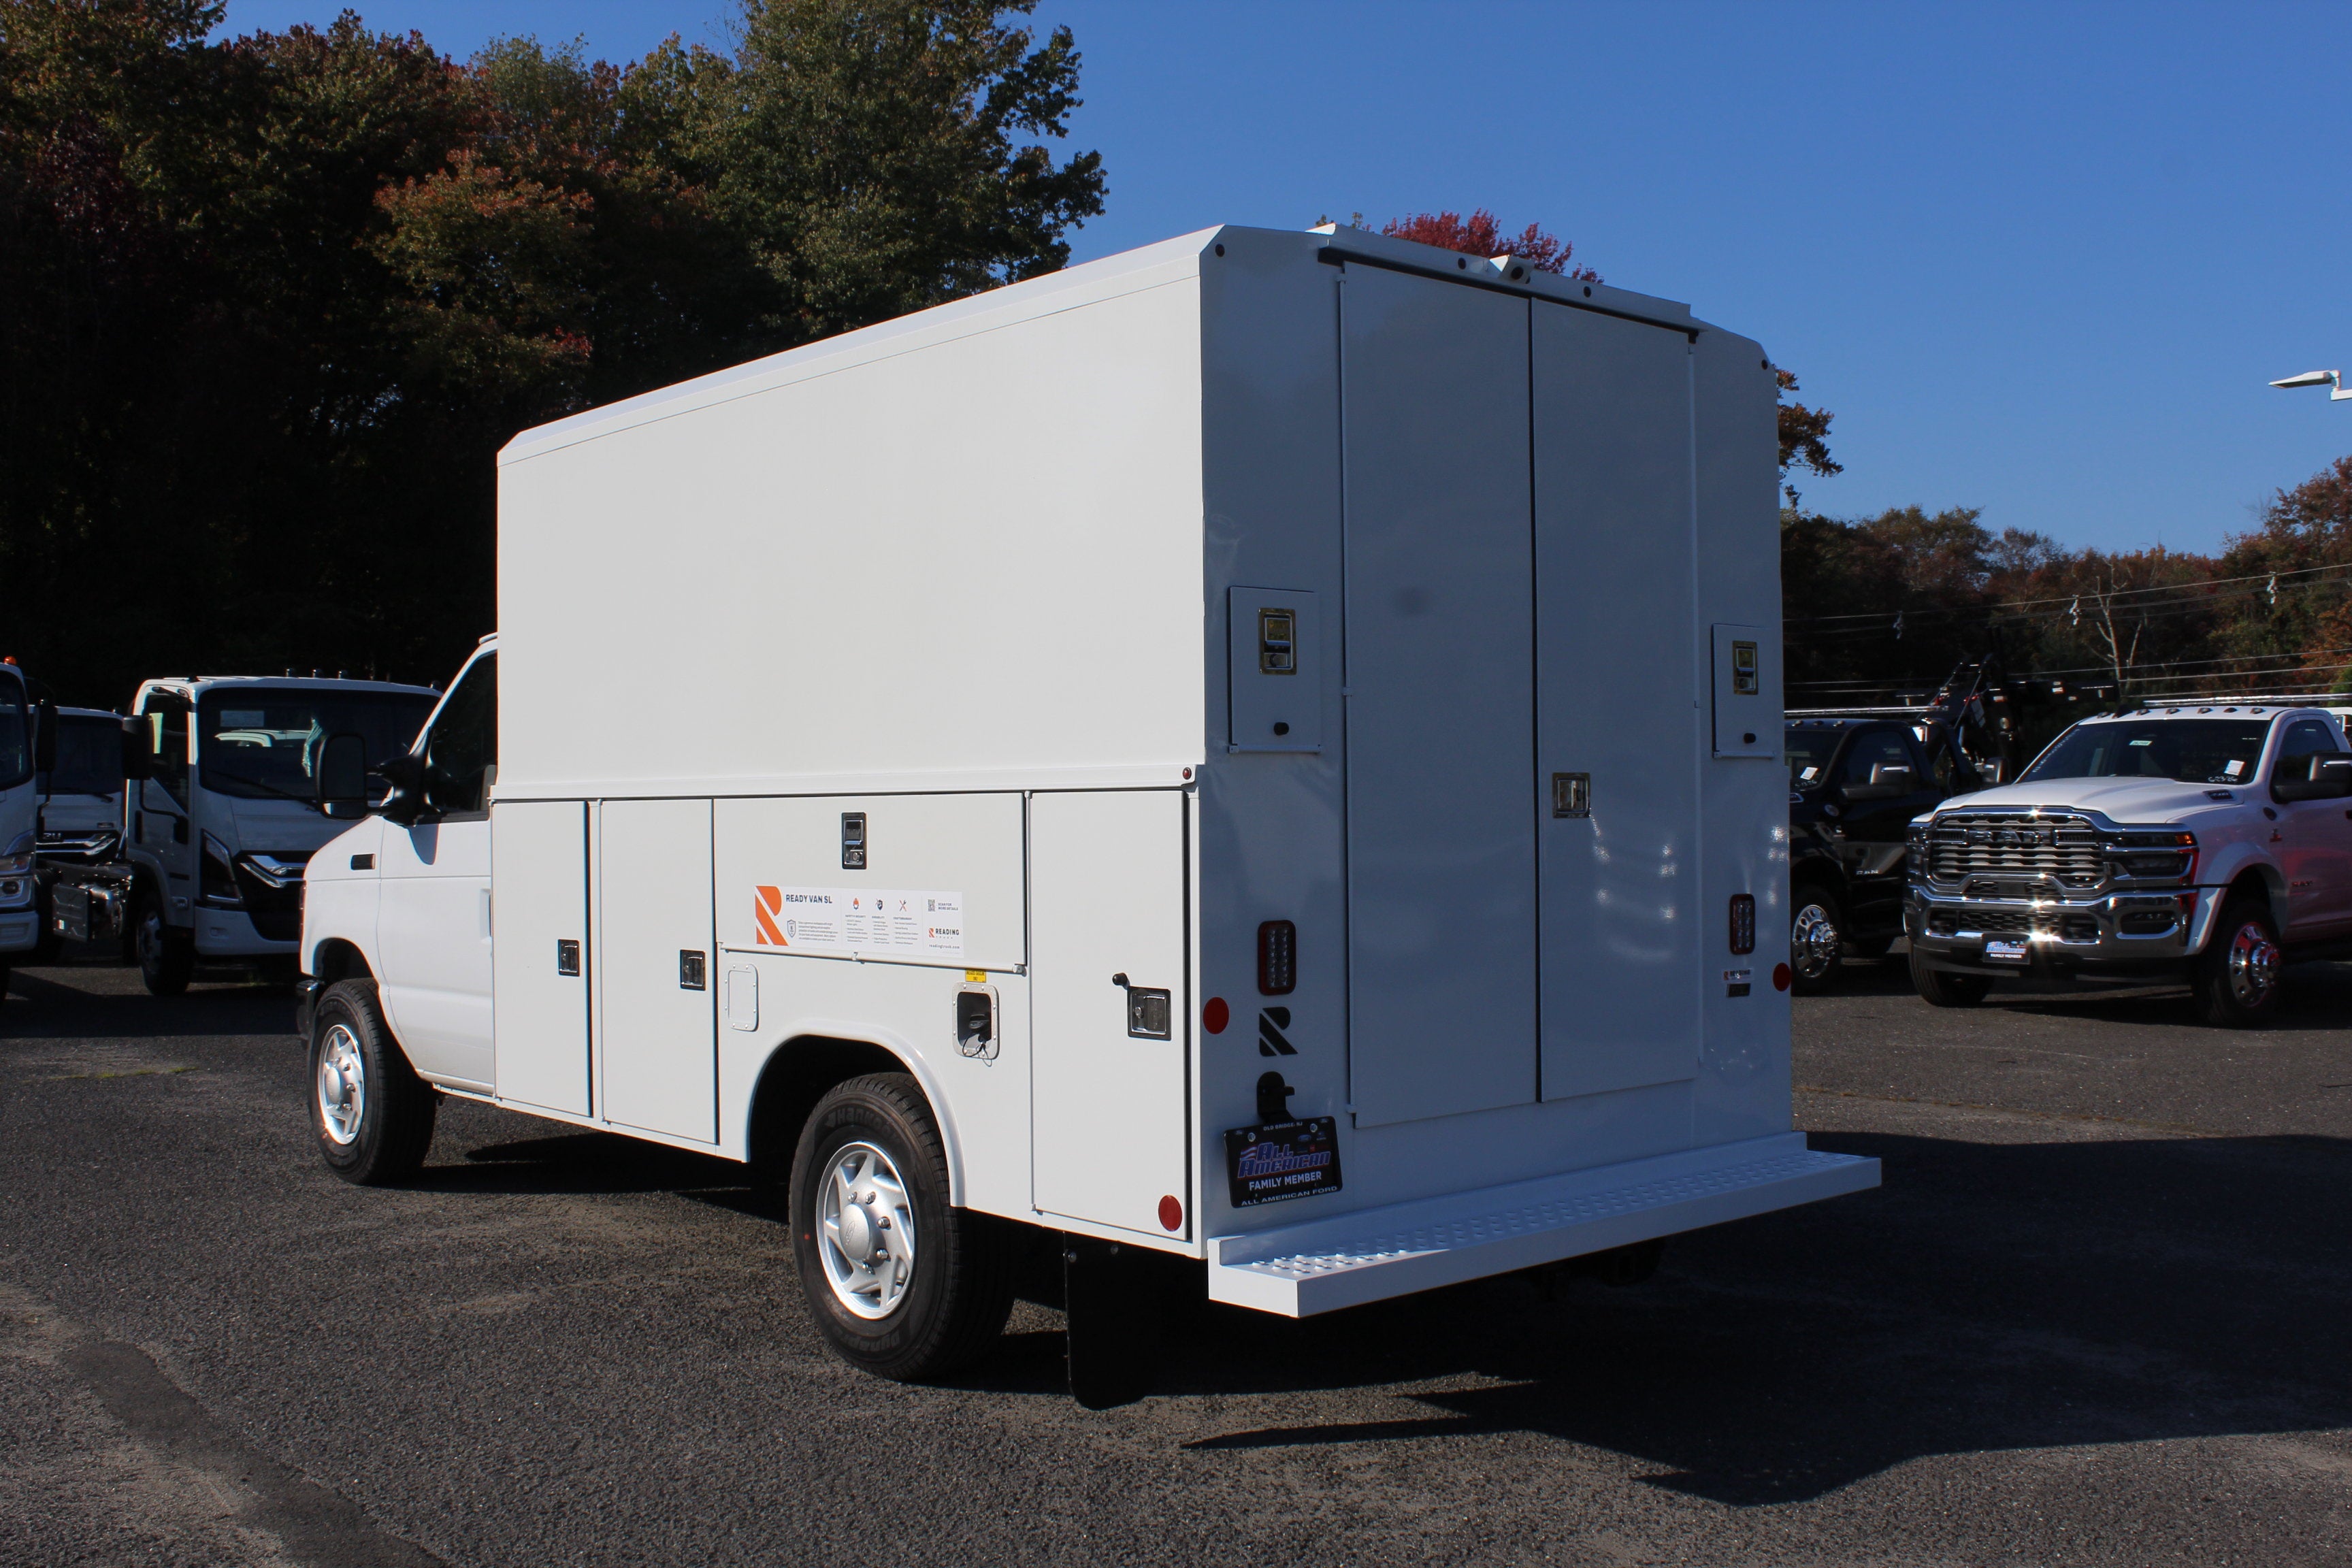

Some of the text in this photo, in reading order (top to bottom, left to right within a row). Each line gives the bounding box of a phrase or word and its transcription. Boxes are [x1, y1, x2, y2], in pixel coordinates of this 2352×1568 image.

[785, 894, 808, 902] READY
[824, 896, 832, 904] SL
[935, 928, 960, 936] READING
[1249, 1171, 1322, 1191] FAMILY MEMBER
[1259, 1191, 1310, 1203] AMERICAN
[1313, 1186, 1337, 1195] FORD
